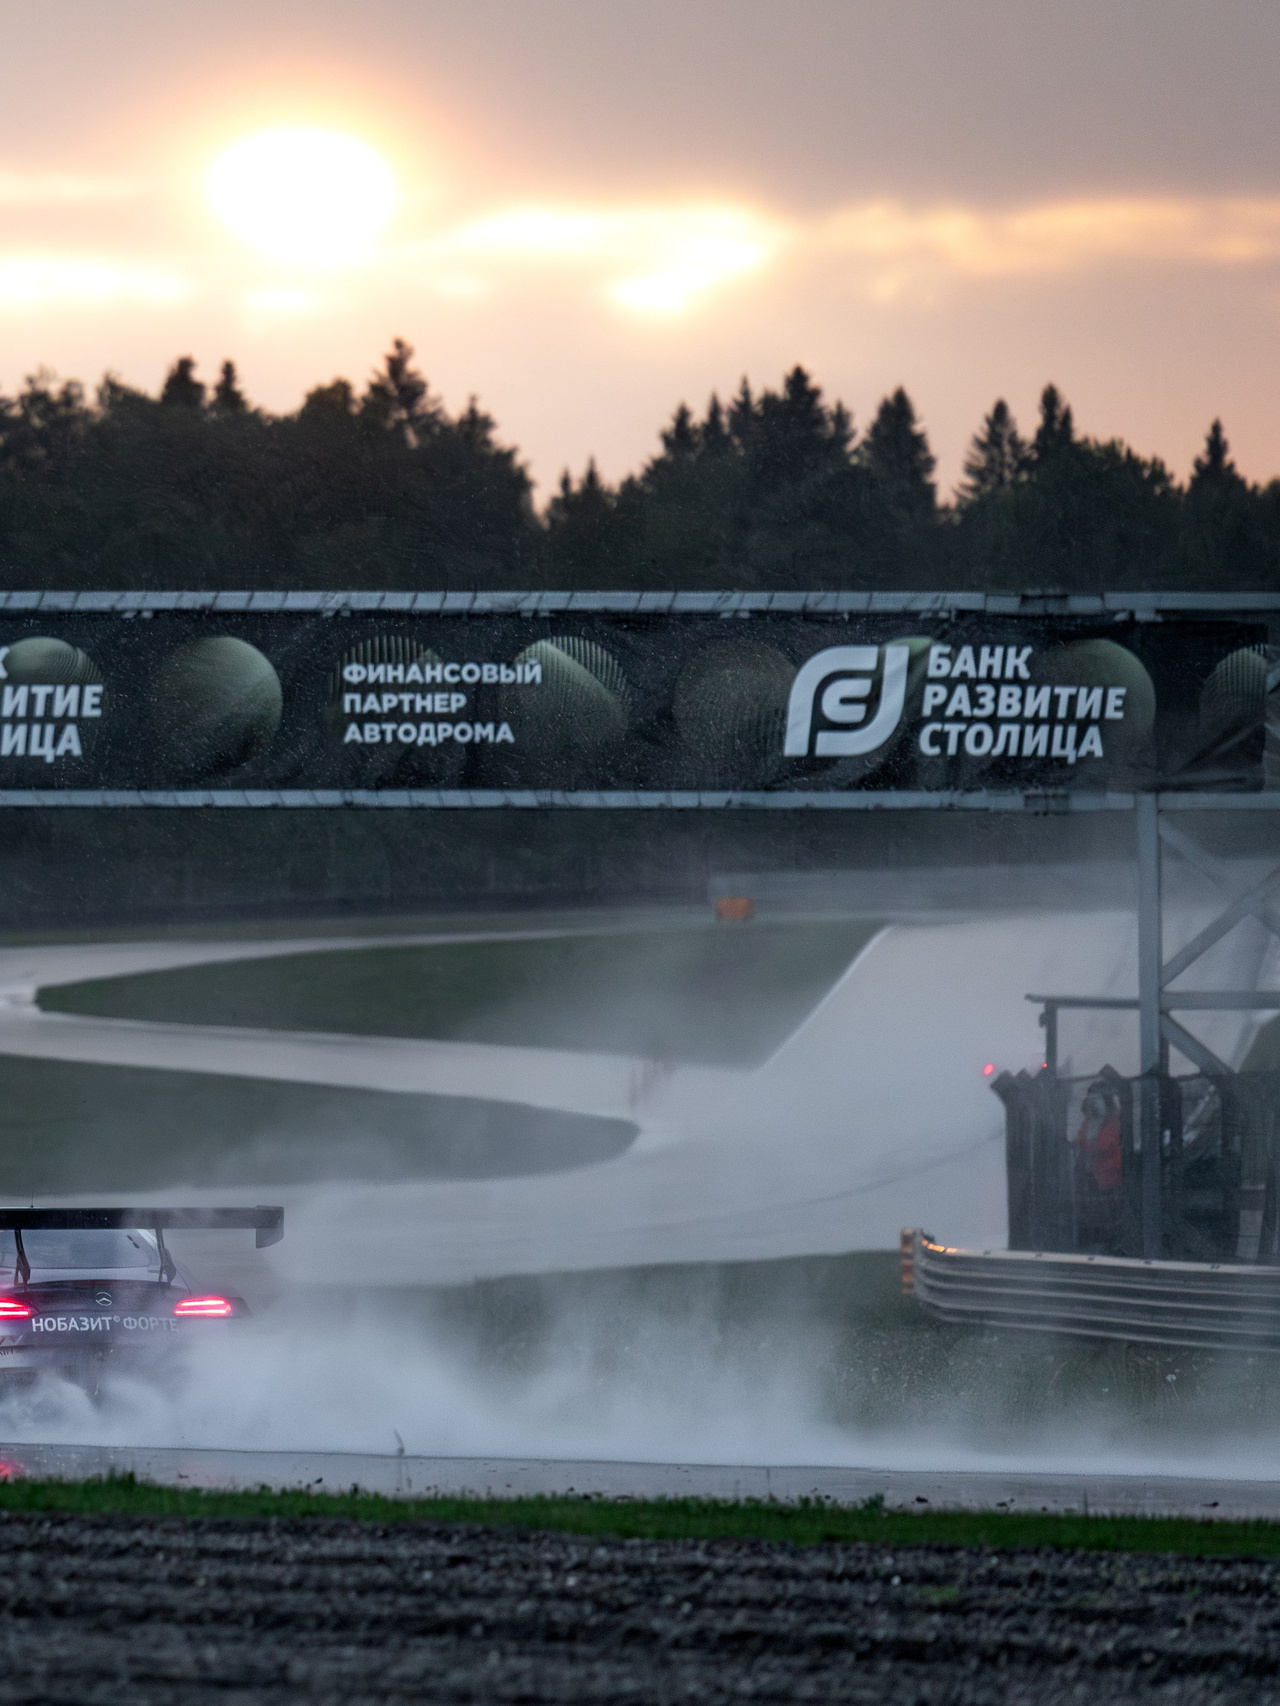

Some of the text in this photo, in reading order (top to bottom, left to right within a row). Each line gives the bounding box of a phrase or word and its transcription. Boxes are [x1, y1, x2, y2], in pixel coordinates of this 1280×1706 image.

[342, 658, 542, 684] ФИНАНСОВЫЙ
[927, 645, 1033, 679] БАНК
[343, 692, 467, 714] ПАРТНЕР
[921, 683, 1127, 719] РАЗВИТИЕ
[343, 721, 516, 747] АВТОДРОМА
[919, 722, 1104, 764] СТОЛИЦА
[123, 1316, 179, 1332] ФОРТЕ
